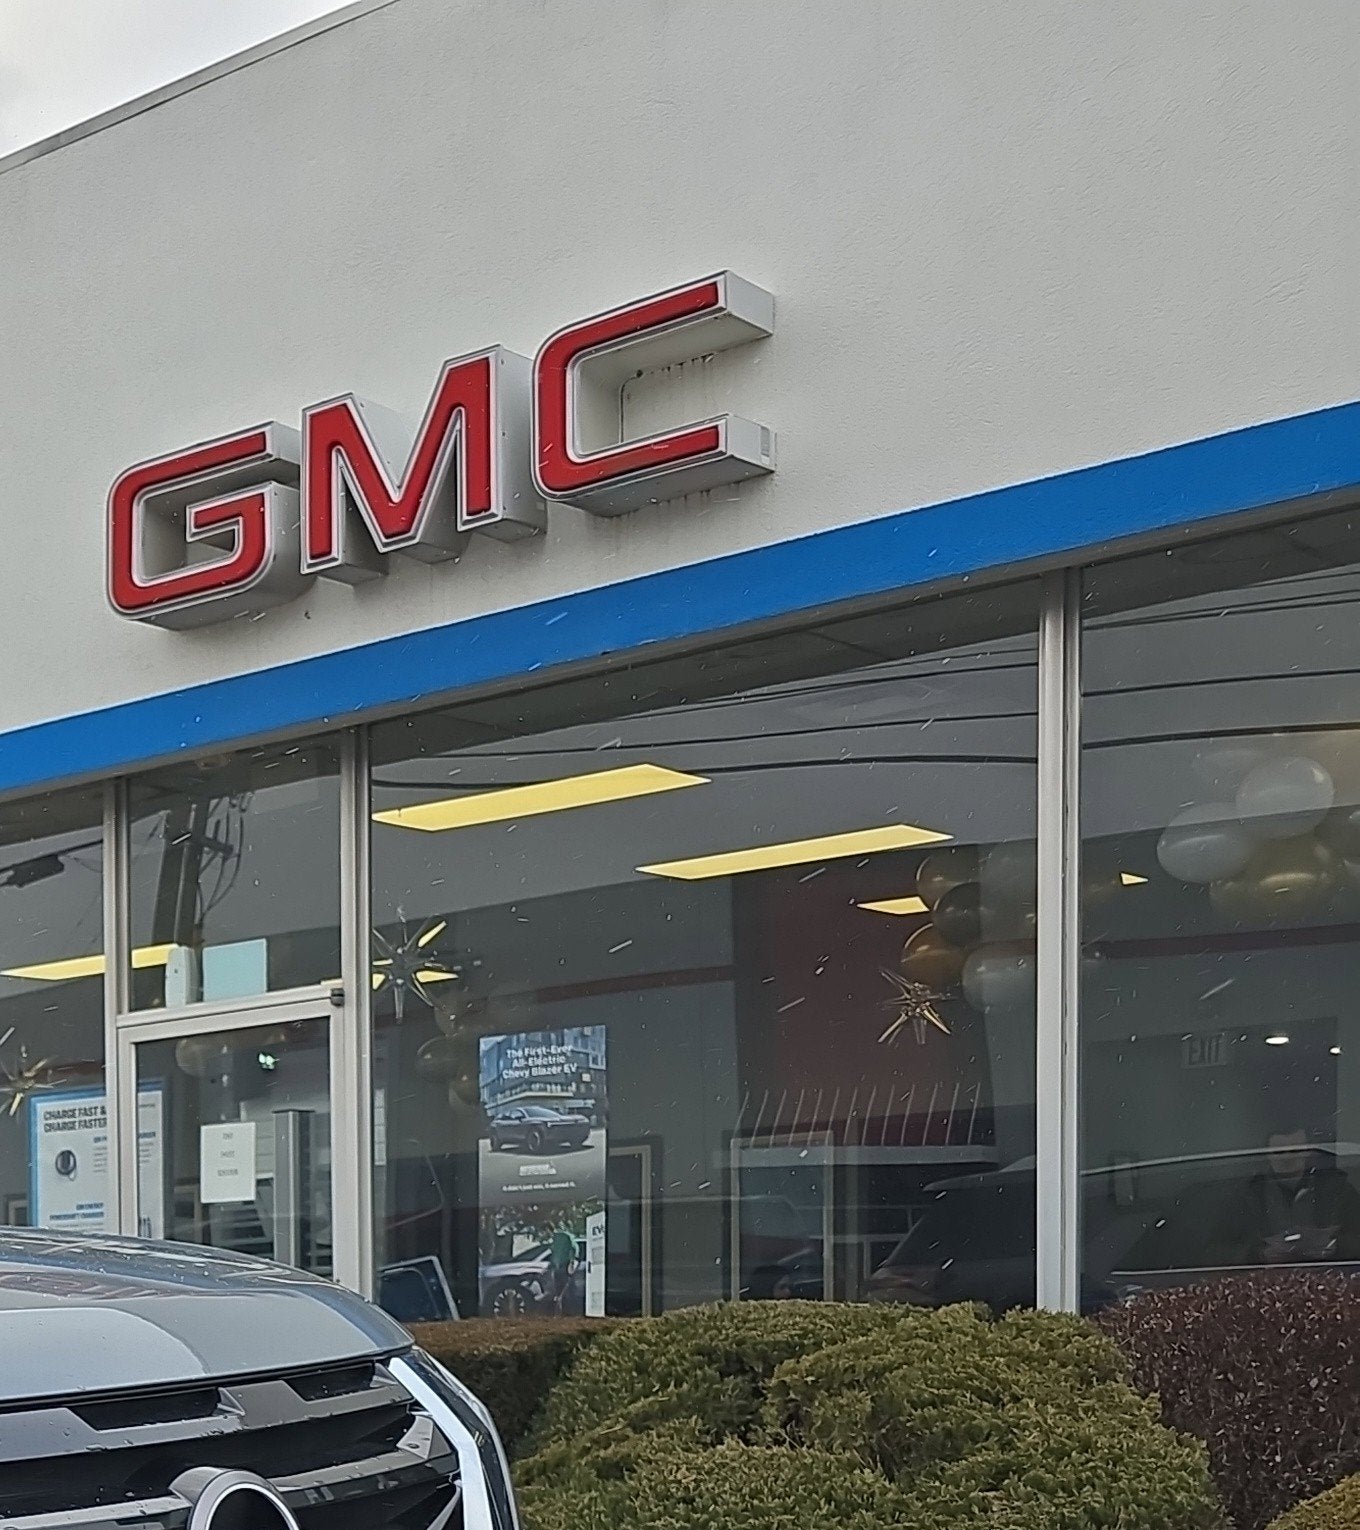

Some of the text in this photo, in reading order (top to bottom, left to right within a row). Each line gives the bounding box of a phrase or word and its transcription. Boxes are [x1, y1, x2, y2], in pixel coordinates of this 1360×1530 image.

[105, 270, 776, 630] GMC
[506, 1049, 523, 1059] The
[502, 1062, 578, 1079] Chevy Blazer EV
[43, 1107, 77, 1121] CHARGE
[78, 1105, 99, 1118] FAST
[43, 1119, 77, 1133] CHARGE
